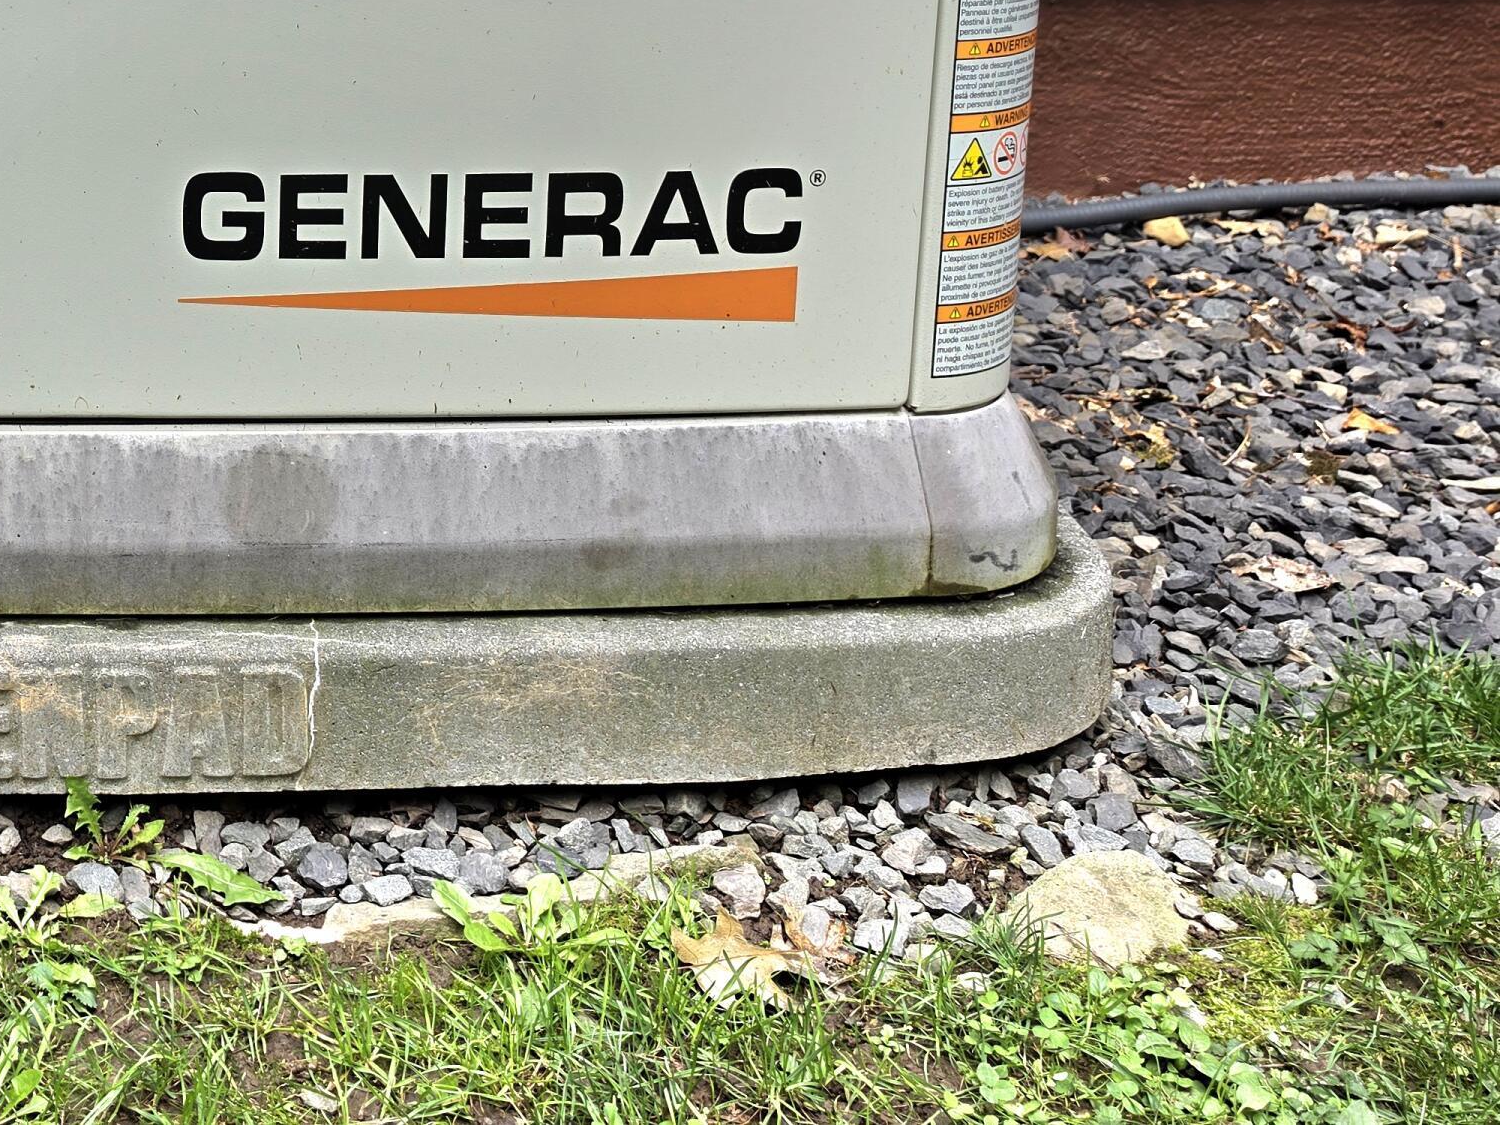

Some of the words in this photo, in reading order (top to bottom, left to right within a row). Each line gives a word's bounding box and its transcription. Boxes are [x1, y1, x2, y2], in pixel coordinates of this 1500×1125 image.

[962, 0, 992, 7] réparable
[991, 7, 999, 15] de
[960, 17, 984, 26] destiné
[992, 15, 1002, 24] être
[960, 27, 992, 36] personnel
[957, 64, 979, 72] Riesgo
[981, 62, 988, 70] de
[956, 73, 977, 82] piezas
[979, 72, 989, 80] que
[956, 82, 977, 90] control
[979, 80, 994, 89] panel
[970, 90, 997, 99] destinado
[967, 99, 993, 109] personal
[949, 189, 980, 198] Explosion
[982, 187, 987, 195] of
[972, 197, 987, 207] injury
[182, 168, 803, 261] GENERAC
[947, 209, 965, 217] strike
[973, 206, 991, 214] match
[947, 218, 970, 227] vicinity
[971, 216, 977, 225] of
[978, 214, 988, 223] this
[944, 253, 980, 263] L'explosion
[943, 264, 966, 272] causer
[968, 261, 978, 270] des
[943, 274, 952, 282] Ne
[954, 273, 966, 283] pas
[942, 283, 971, 292] allumette
[941, 292, 970, 302] proximité
[971, 291, 979, 299] de
[938, 327, 947, 335] La
[949, 324, 978, 335] explosión
[979, 322, 986, 330] de
[938, 335, 959, 345] puede
[960, 334, 980, 342] causar
[937, 345, 962, 354] muerte.
[936, 355, 942, 363] ni
[944, 353, 961, 363] haga
